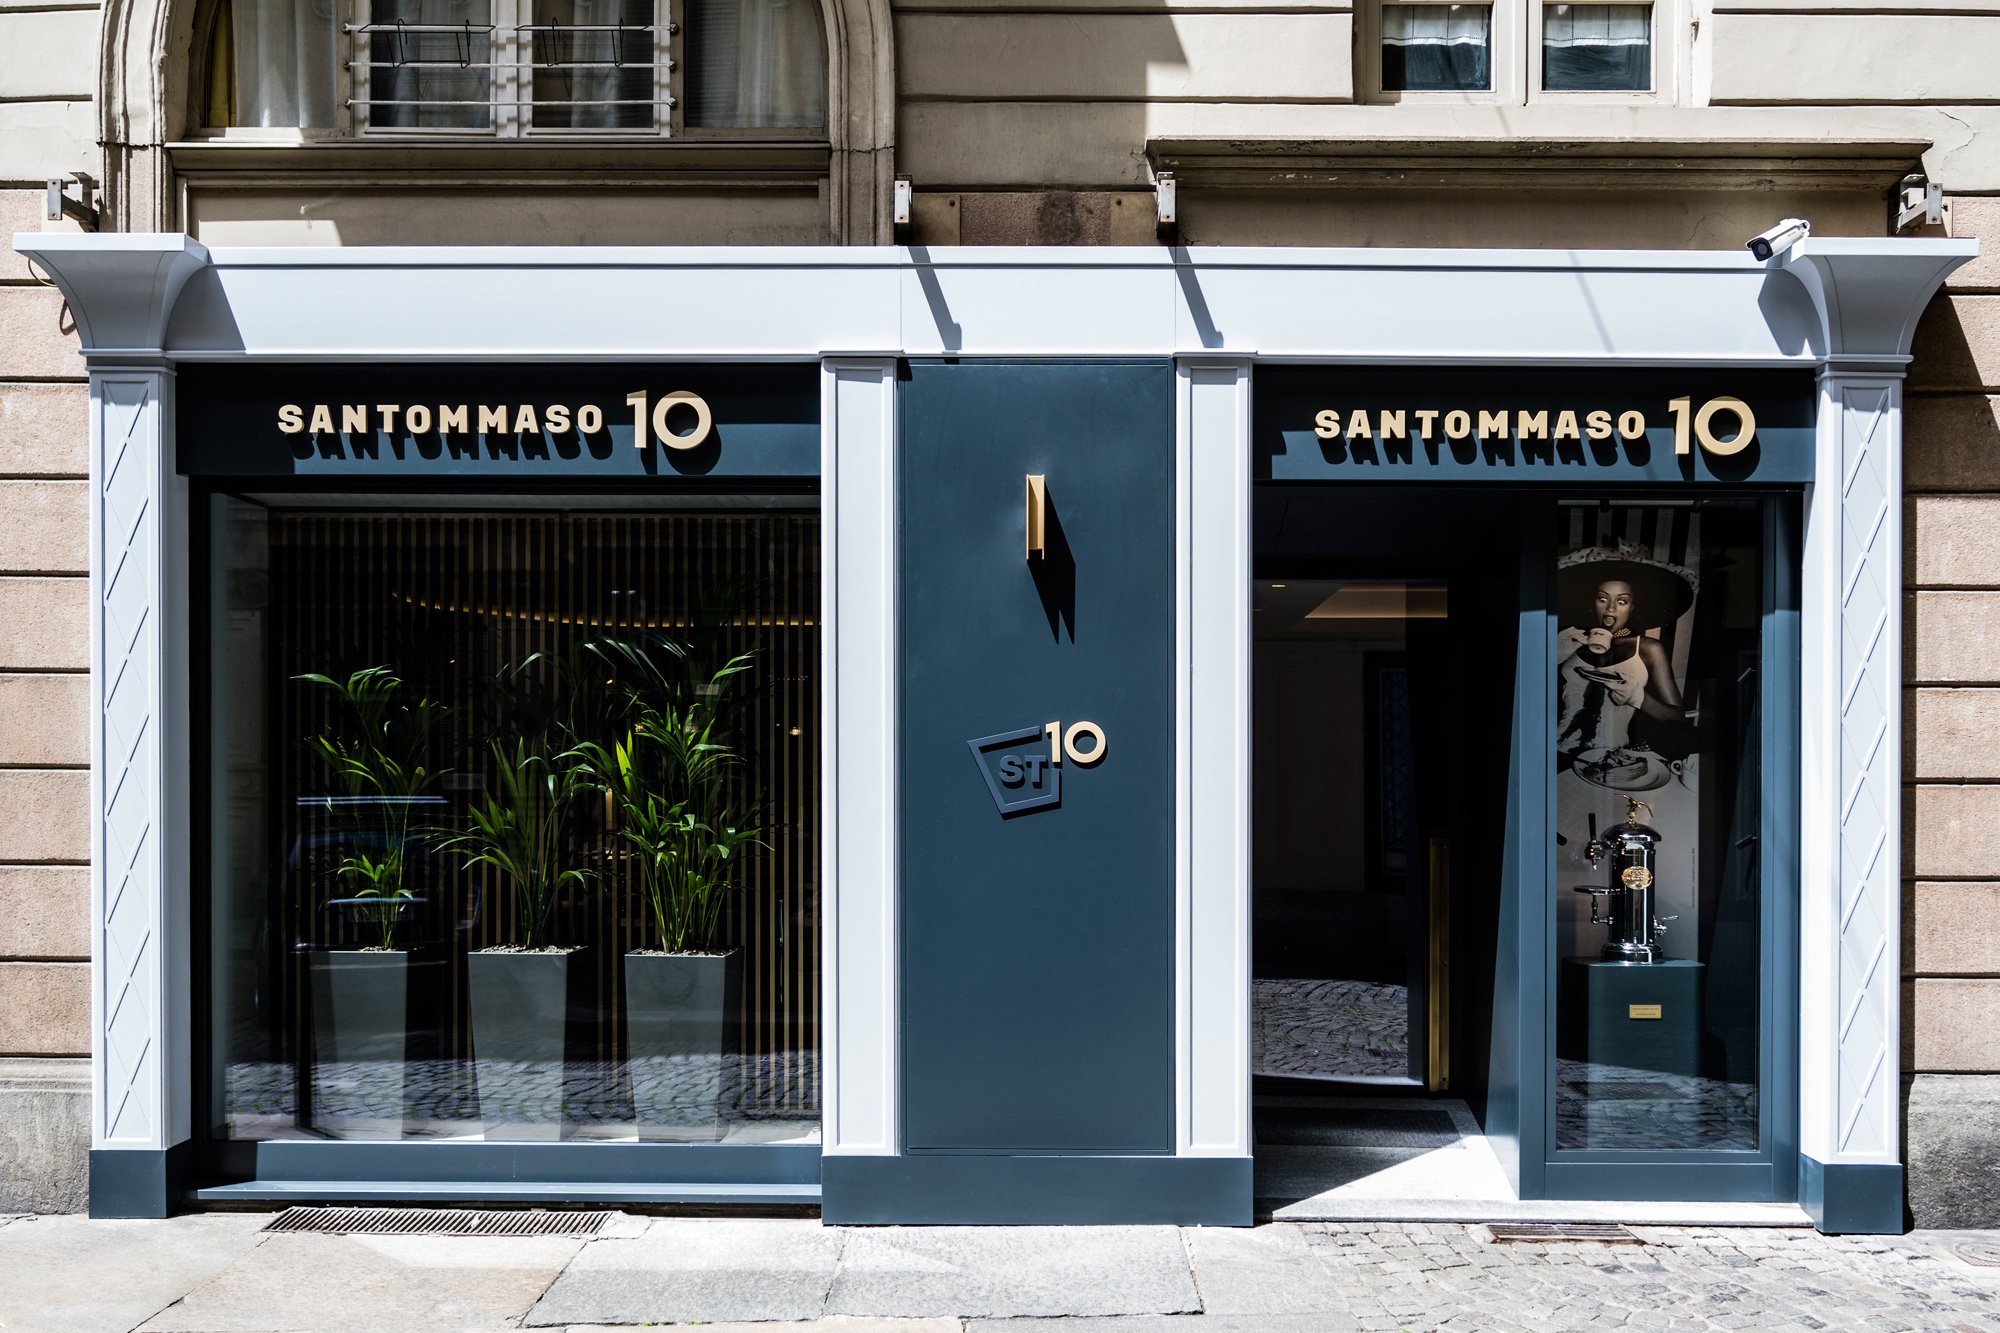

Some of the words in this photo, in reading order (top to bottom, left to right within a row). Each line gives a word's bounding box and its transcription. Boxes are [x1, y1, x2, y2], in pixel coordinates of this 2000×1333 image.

[277, 404, 603, 434] SANTOMMASO
[626, 390, 711, 450] 10
[1314, 409, 1646, 440] SANTOMMASO
[1668, 395, 1757, 456] 10
[1045, 720, 1107, 763] 10
